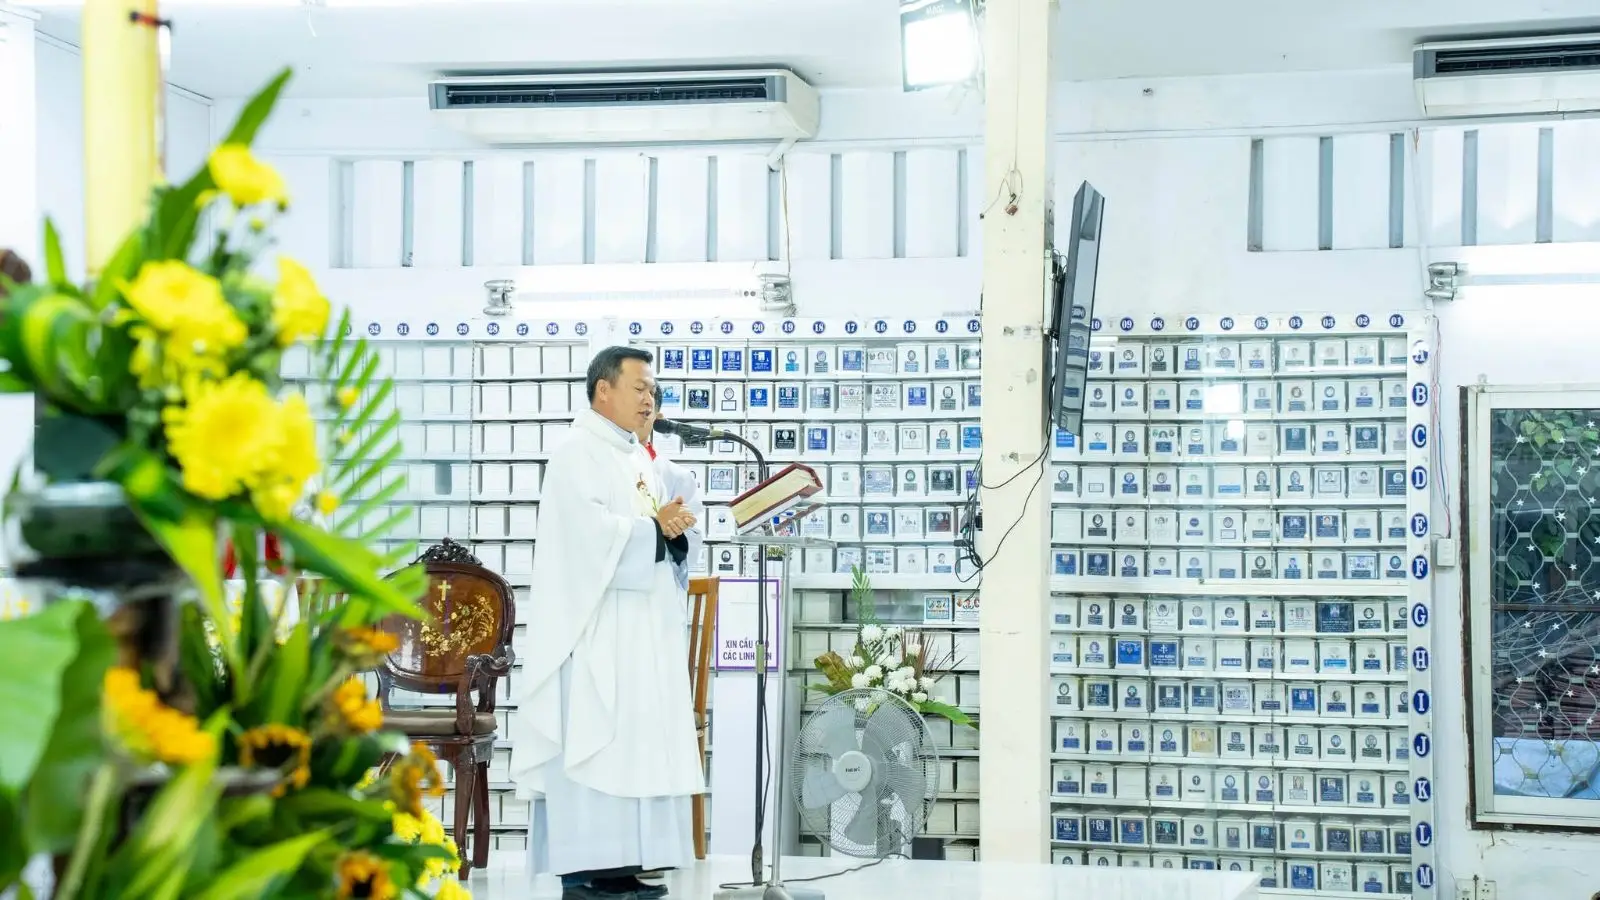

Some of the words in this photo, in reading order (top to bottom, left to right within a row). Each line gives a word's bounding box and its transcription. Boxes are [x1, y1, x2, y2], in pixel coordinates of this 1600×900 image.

[398, 325, 408, 334] 31
[692, 323, 702, 332] 22
[722, 323, 732, 332] 21
[753, 324, 763, 332] 20
[783, 323, 792, 331] 19
[814, 323, 823, 331] 18
[846, 324, 856, 332] 17
[876, 322, 886, 331] 16
[905, 322, 915, 331] 15
[937, 322, 947, 331] 14
[968, 321, 978, 331] 13
[1122, 319, 1132, 329] 09
[1152, 319, 1163, 329] 08
[1187, 319, 1198, 329] 07
[1222, 319, 1232, 328] 06
[1256, 319, 1267, 327] 05
[1290, 318, 1301, 326] 04
[1323, 318, 1334, 327] 03
[1357, 316, 1368, 326] 02
[1391, 316, 1402, 326] 01
[1414, 385, 1427, 403] B
[1413, 427, 1427, 445] C
[1414, 469, 1427, 487] D
[1414, 516, 1426, 534] E
[1414, 558, 1426, 577] F
[1414, 605, 1427, 625] G
[725, 640, 737, 648] XIN
[723, 650, 737, 660] CÁC
[739, 652, 755, 660] LINH
[1415, 649, 1427, 669] H
[1417, 693, 1425, 712] I
[1417, 736, 1427, 755] J
[1417, 780, 1429, 800] K
[1419, 825, 1430, 844] L
[1419, 867, 1431, 886] M
